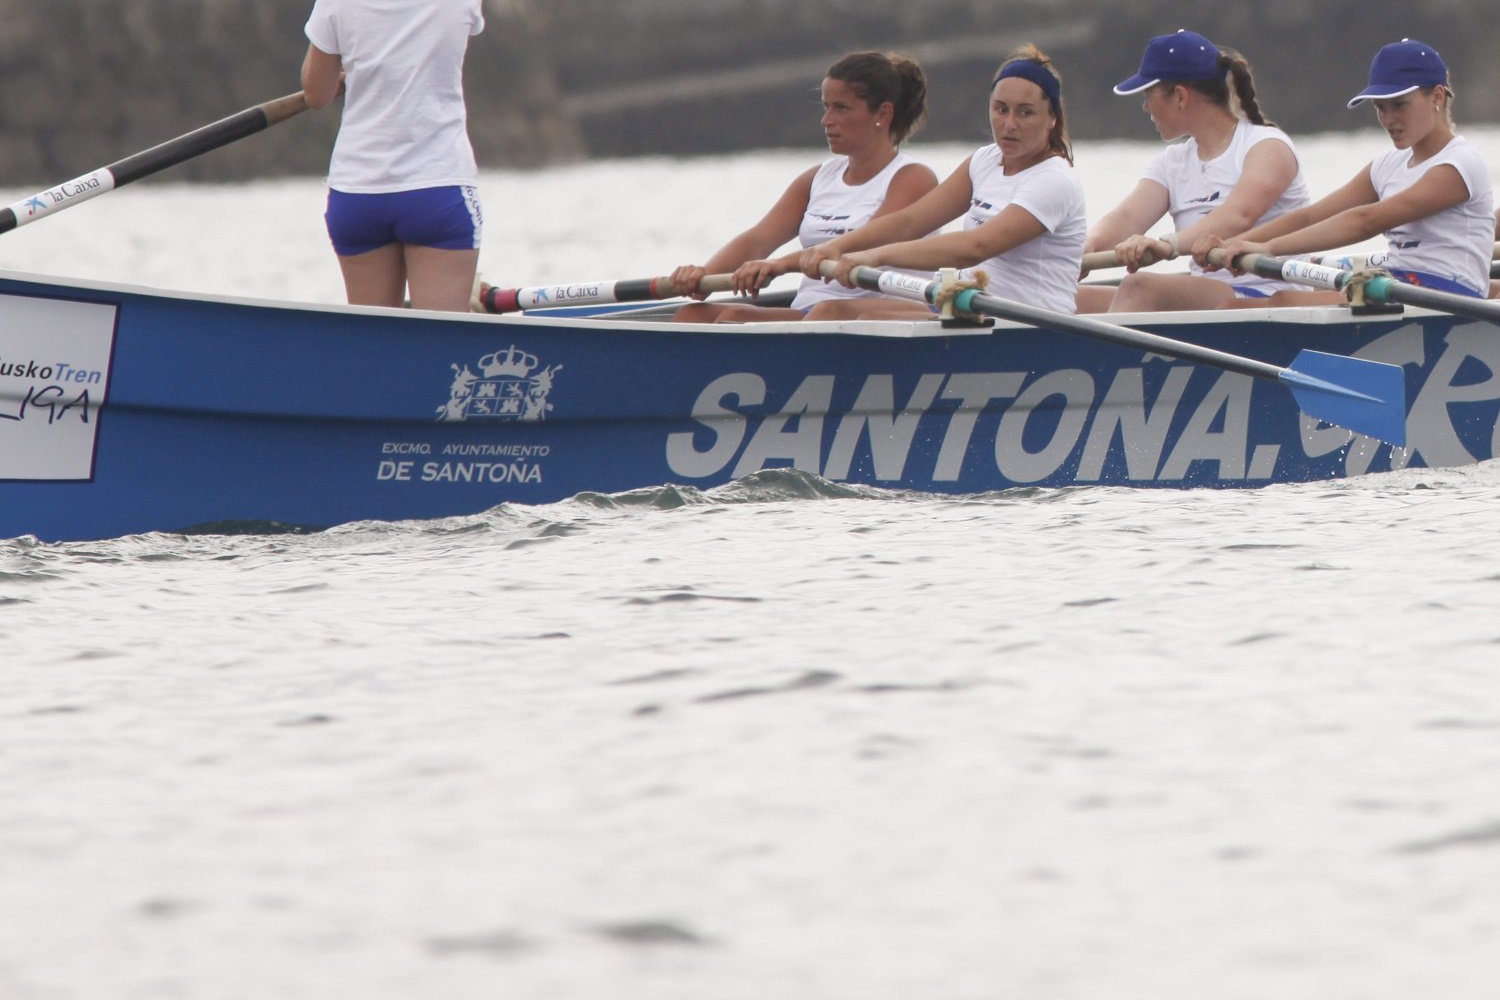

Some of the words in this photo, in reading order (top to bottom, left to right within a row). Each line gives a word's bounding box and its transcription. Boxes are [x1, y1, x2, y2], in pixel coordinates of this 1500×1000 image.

[0, 357, 102, 385] uskoTren
[381, 442, 431, 455] EXCMO.
[442, 443, 550, 457] AYUNTAMIENTO
[376, 460, 414, 481] DE
[420, 457, 543, 484] SANTOÑA
